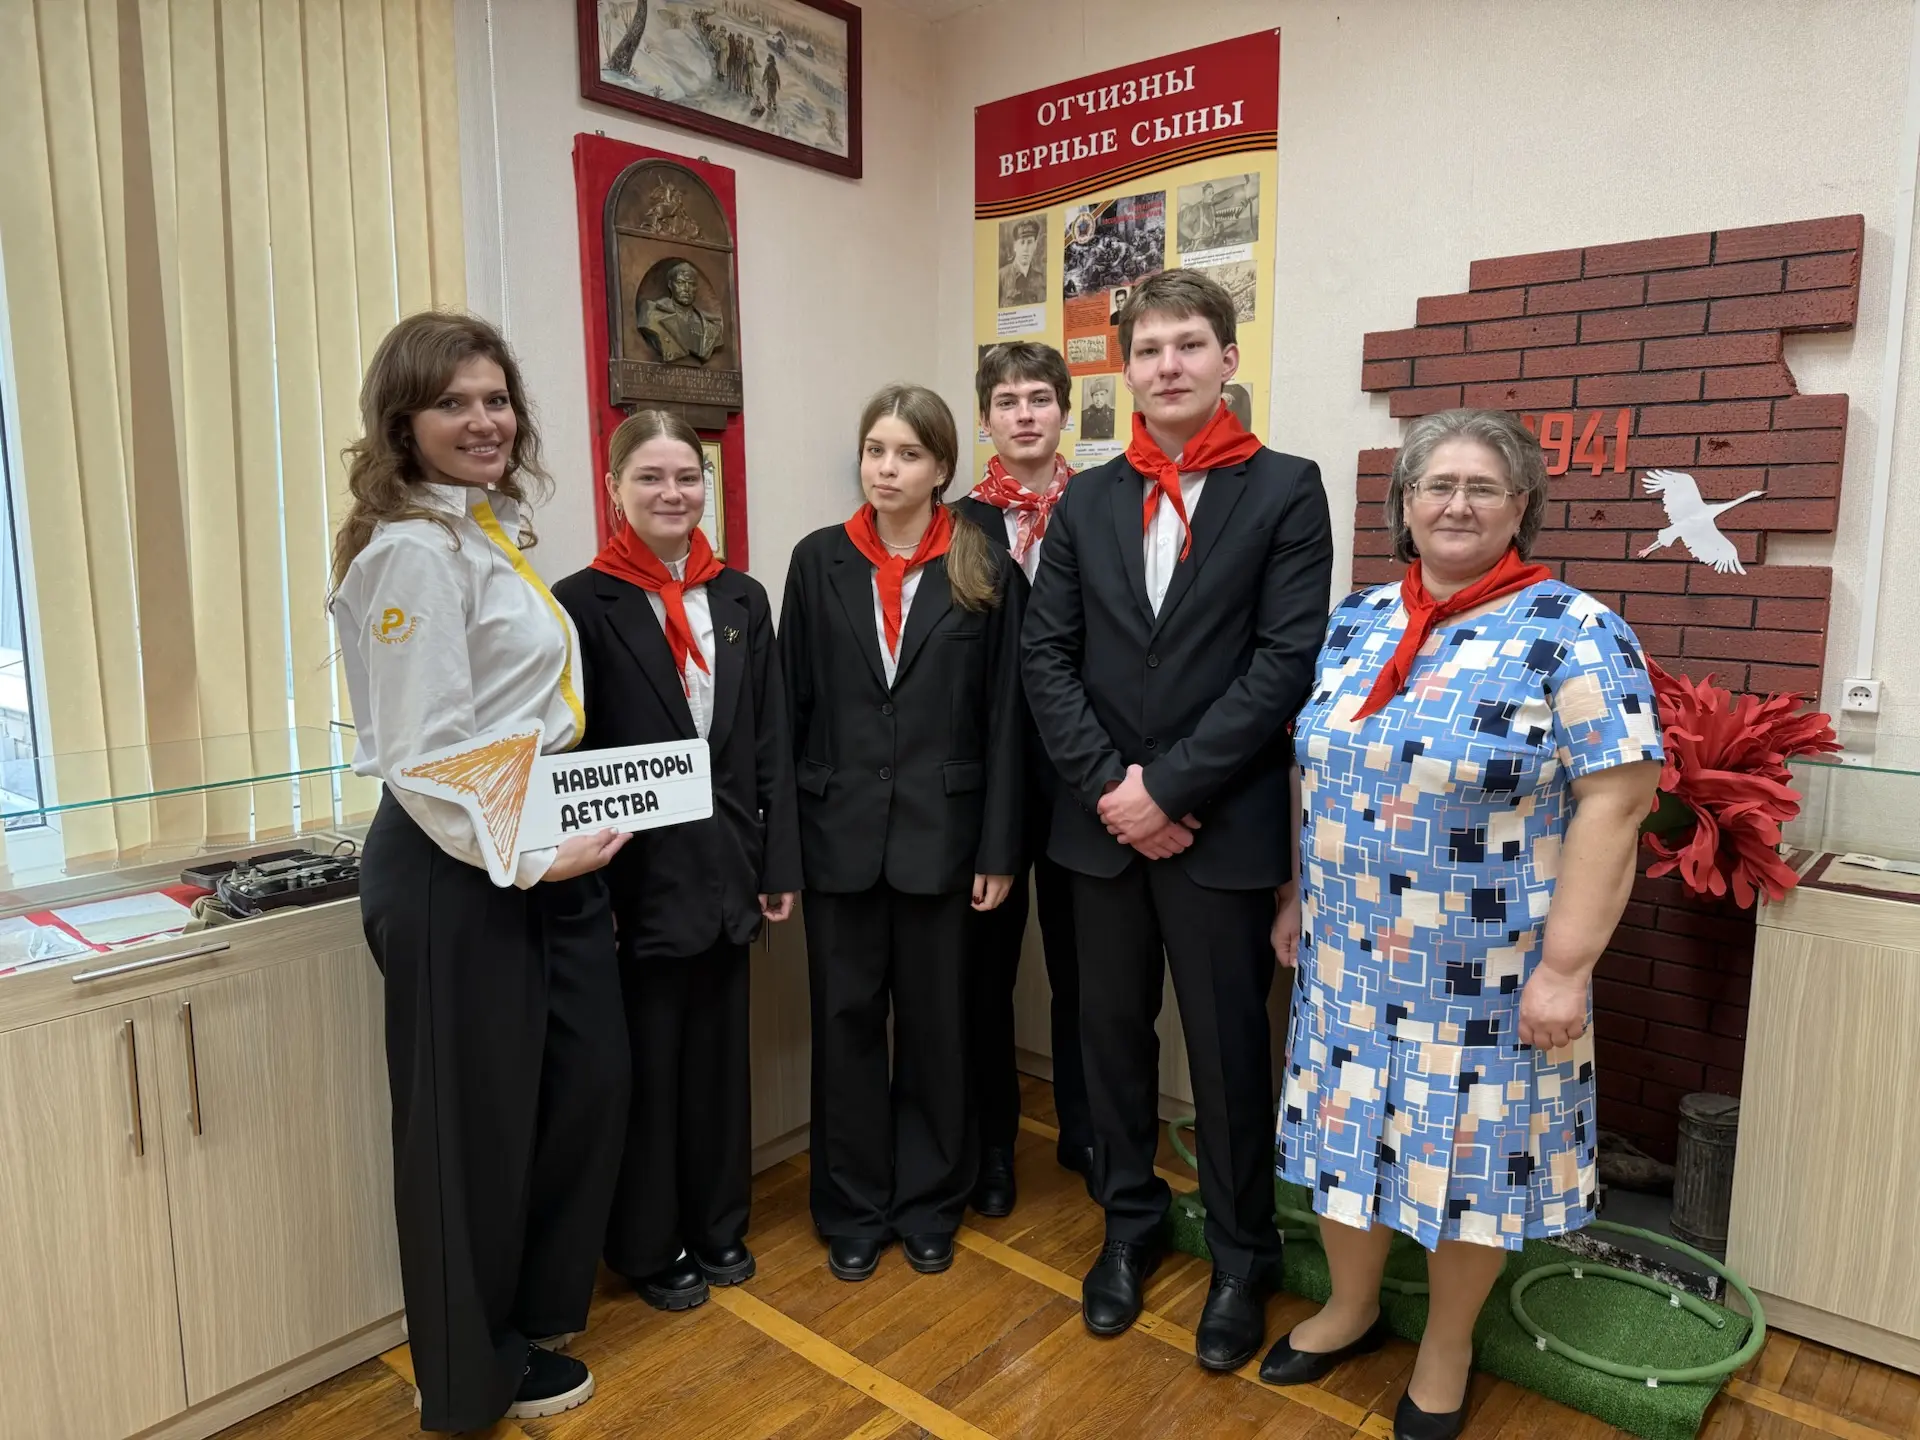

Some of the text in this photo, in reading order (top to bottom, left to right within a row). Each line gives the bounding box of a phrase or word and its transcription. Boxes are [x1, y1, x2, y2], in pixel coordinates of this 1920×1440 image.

[1036, 65, 1196, 126] ОТЧИЗНЫ
[998, 100, 1245, 177] ВЕРНЫЕ СЫНЫ
[552, 753, 694, 794] НАВИГАТОРЫ
[560, 790, 660, 832] ДЕТСТВА
